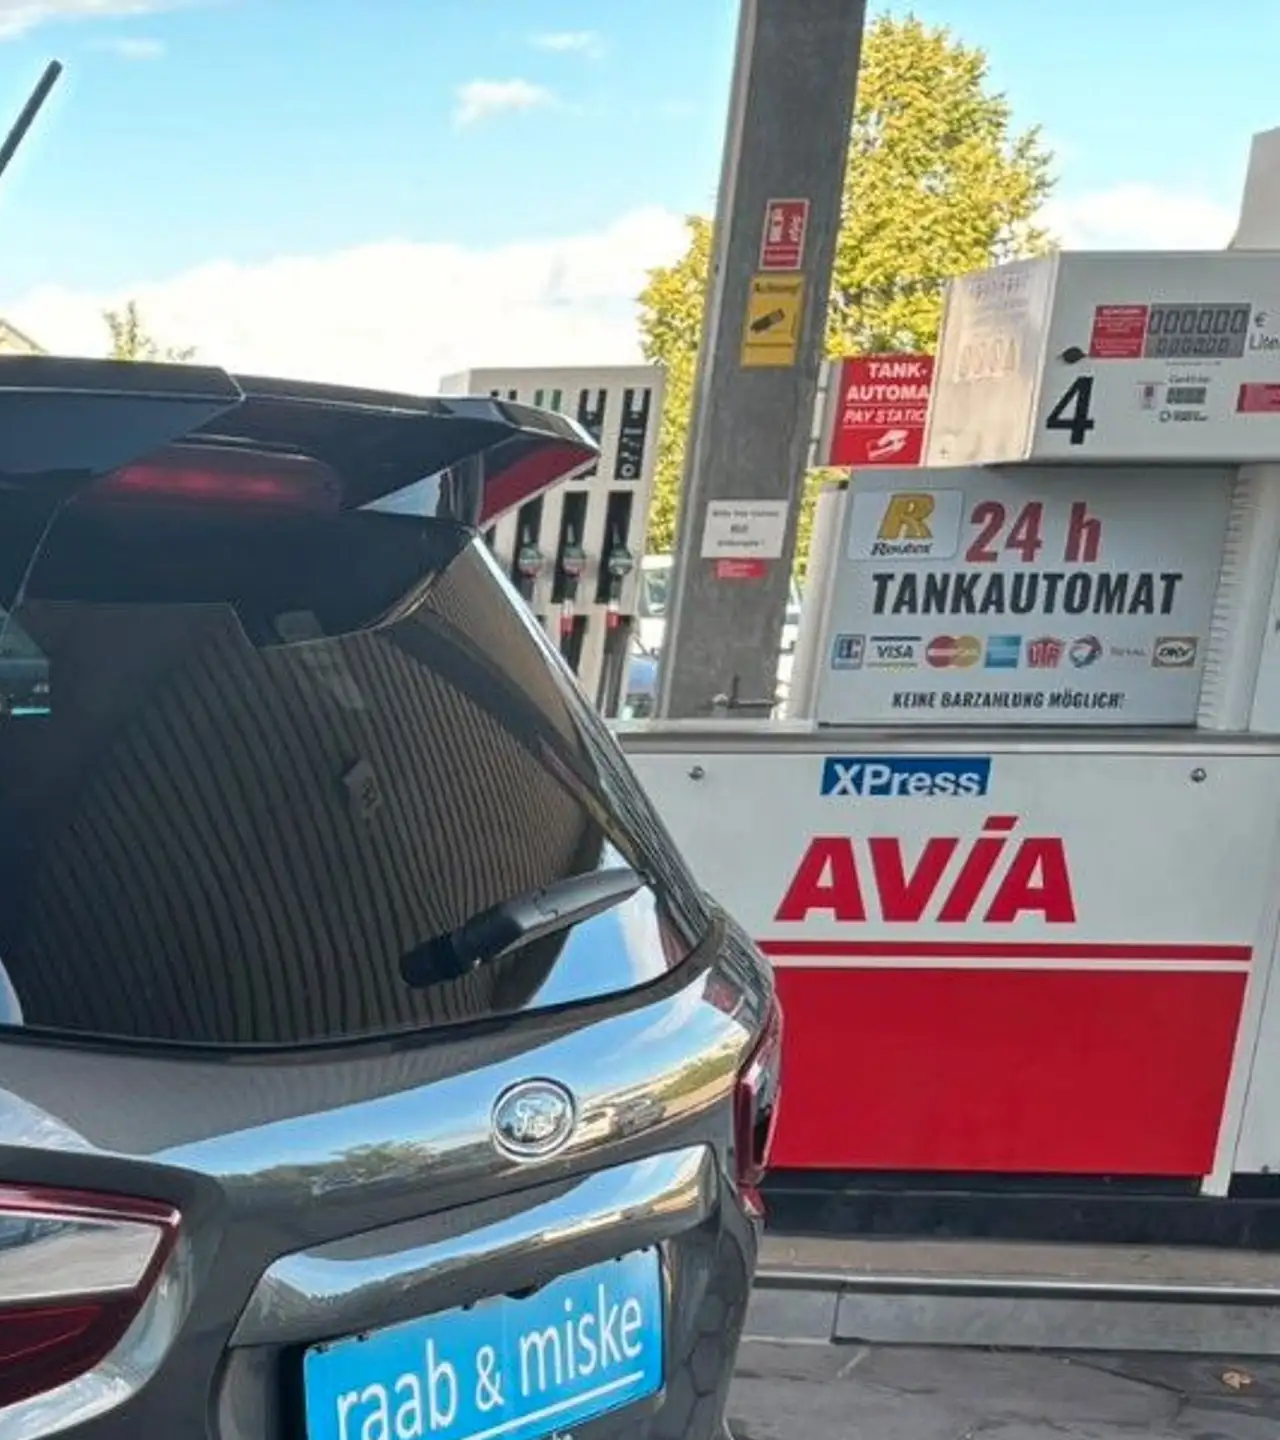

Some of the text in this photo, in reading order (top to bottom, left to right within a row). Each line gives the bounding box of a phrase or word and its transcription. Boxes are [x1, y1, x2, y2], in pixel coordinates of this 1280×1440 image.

[868, 362, 927, 379] TANK-
[847, 384, 929, 401] AUTOMA
[844, 409, 926, 424] PAY STATIO
[1046, 376, 1095, 445] 4
[965, 500, 1103, 563] 24 h
[871, 541, 933, 557] Routex
[872, 572, 1183, 615] TANKAUTOMAT
[877, 644, 914, 659] VISA
[892, 691, 937, 709] KEINE
[941, 690, 1044, 710] BARZAHLUNG
[829, 763, 982, 796] XPress
[475, 1343, 505, 1413] &
[519, 1283, 643, 1398] miske
